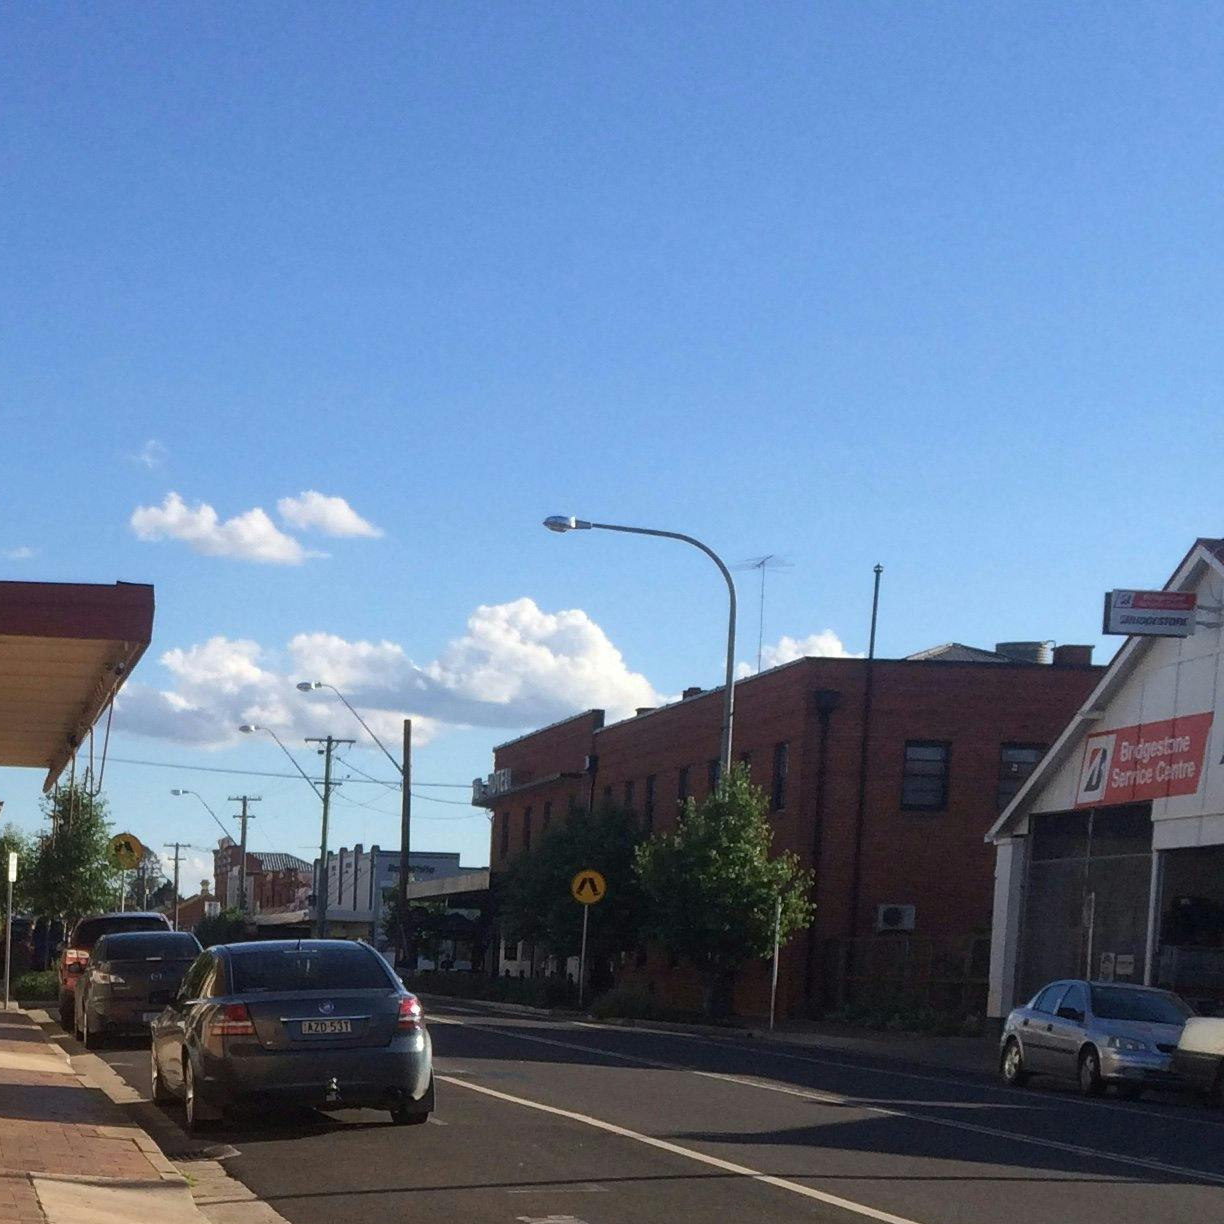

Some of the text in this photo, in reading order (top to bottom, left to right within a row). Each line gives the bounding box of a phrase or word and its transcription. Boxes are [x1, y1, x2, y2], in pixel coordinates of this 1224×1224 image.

[1120, 736, 1191, 762] Bridgestone
[1111, 760, 1196, 788] Service Centre
